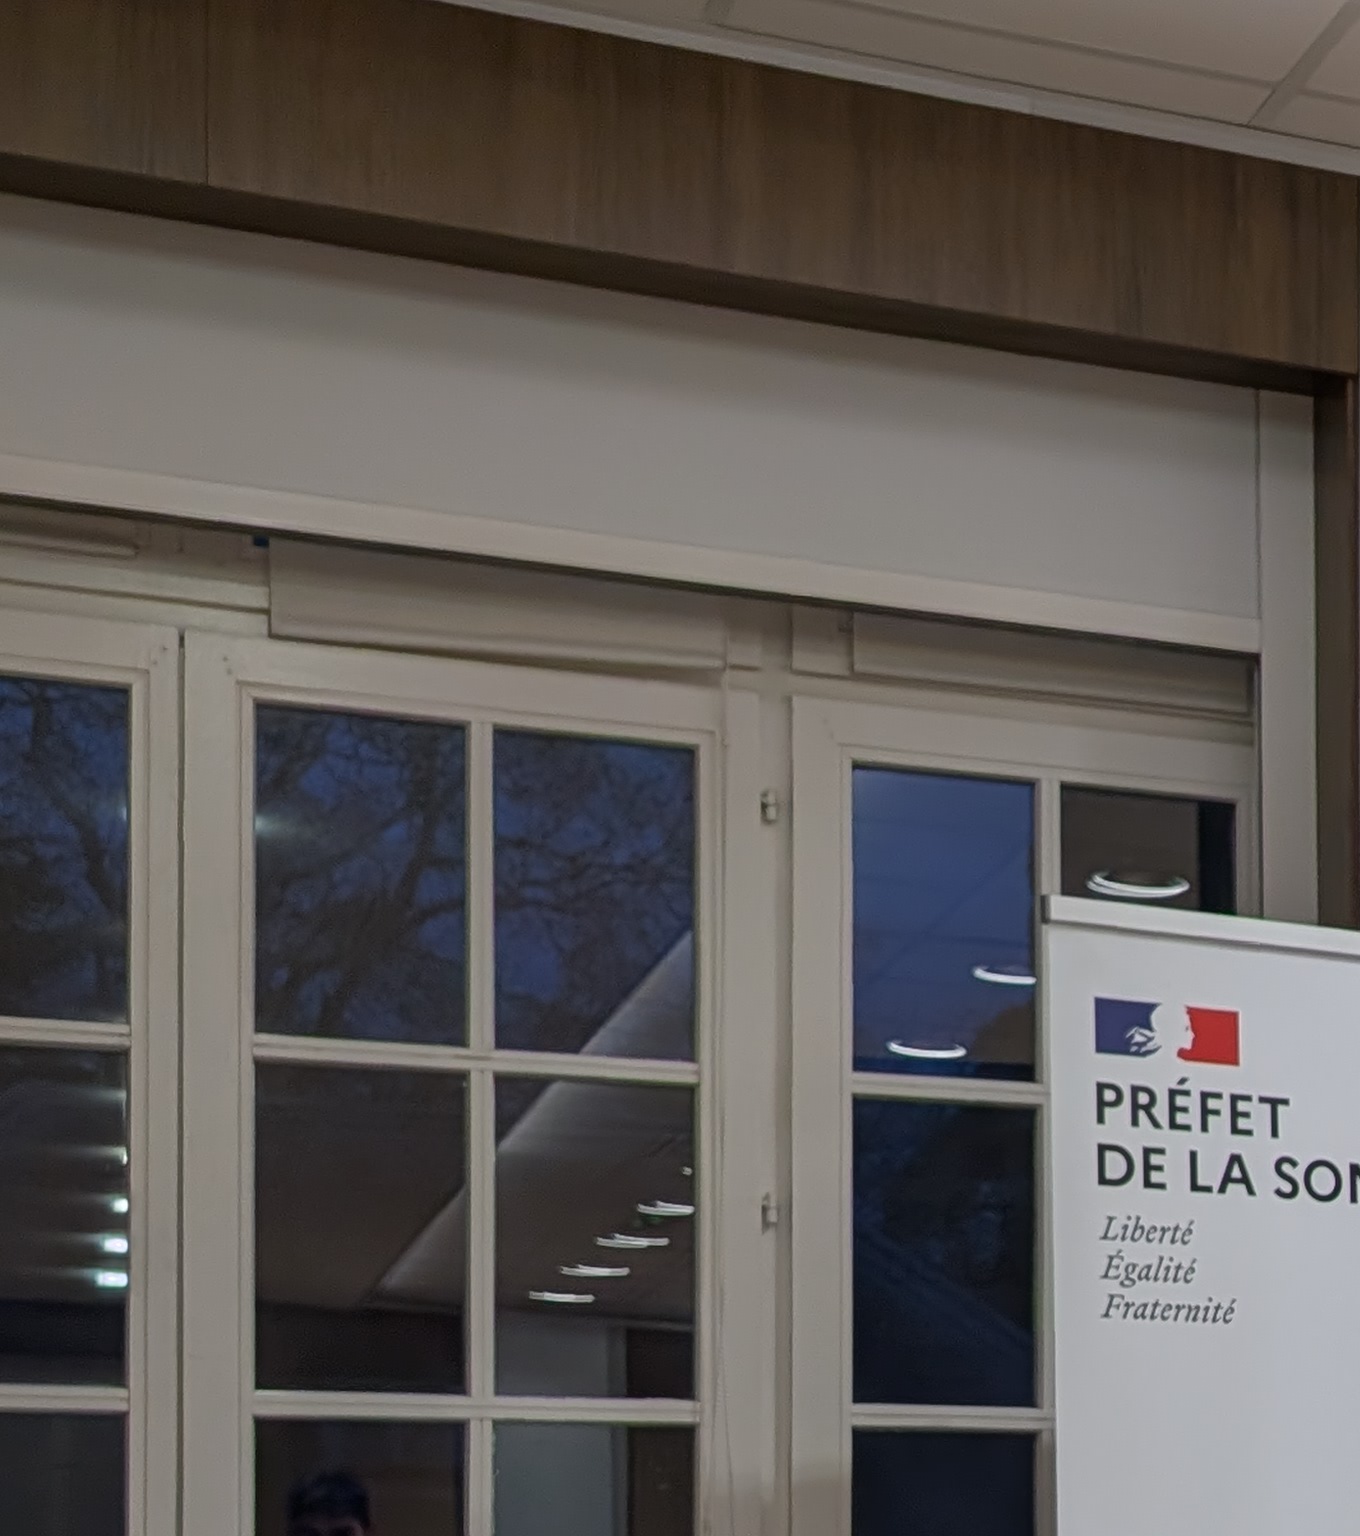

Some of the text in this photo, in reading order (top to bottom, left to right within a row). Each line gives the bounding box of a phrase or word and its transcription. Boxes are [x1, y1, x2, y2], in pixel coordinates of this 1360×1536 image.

[1095, 1076, 1290, 1139] PRÉFET
[1096, 1142, 1168, 1191] DE
[1188, 1149, 1257, 1197] LA
[1099, 1215, 1195, 1246] Liberté
[1100, 1249, 1197, 1289] Égalité
[1100, 1293, 1237, 1325] Fraternité
